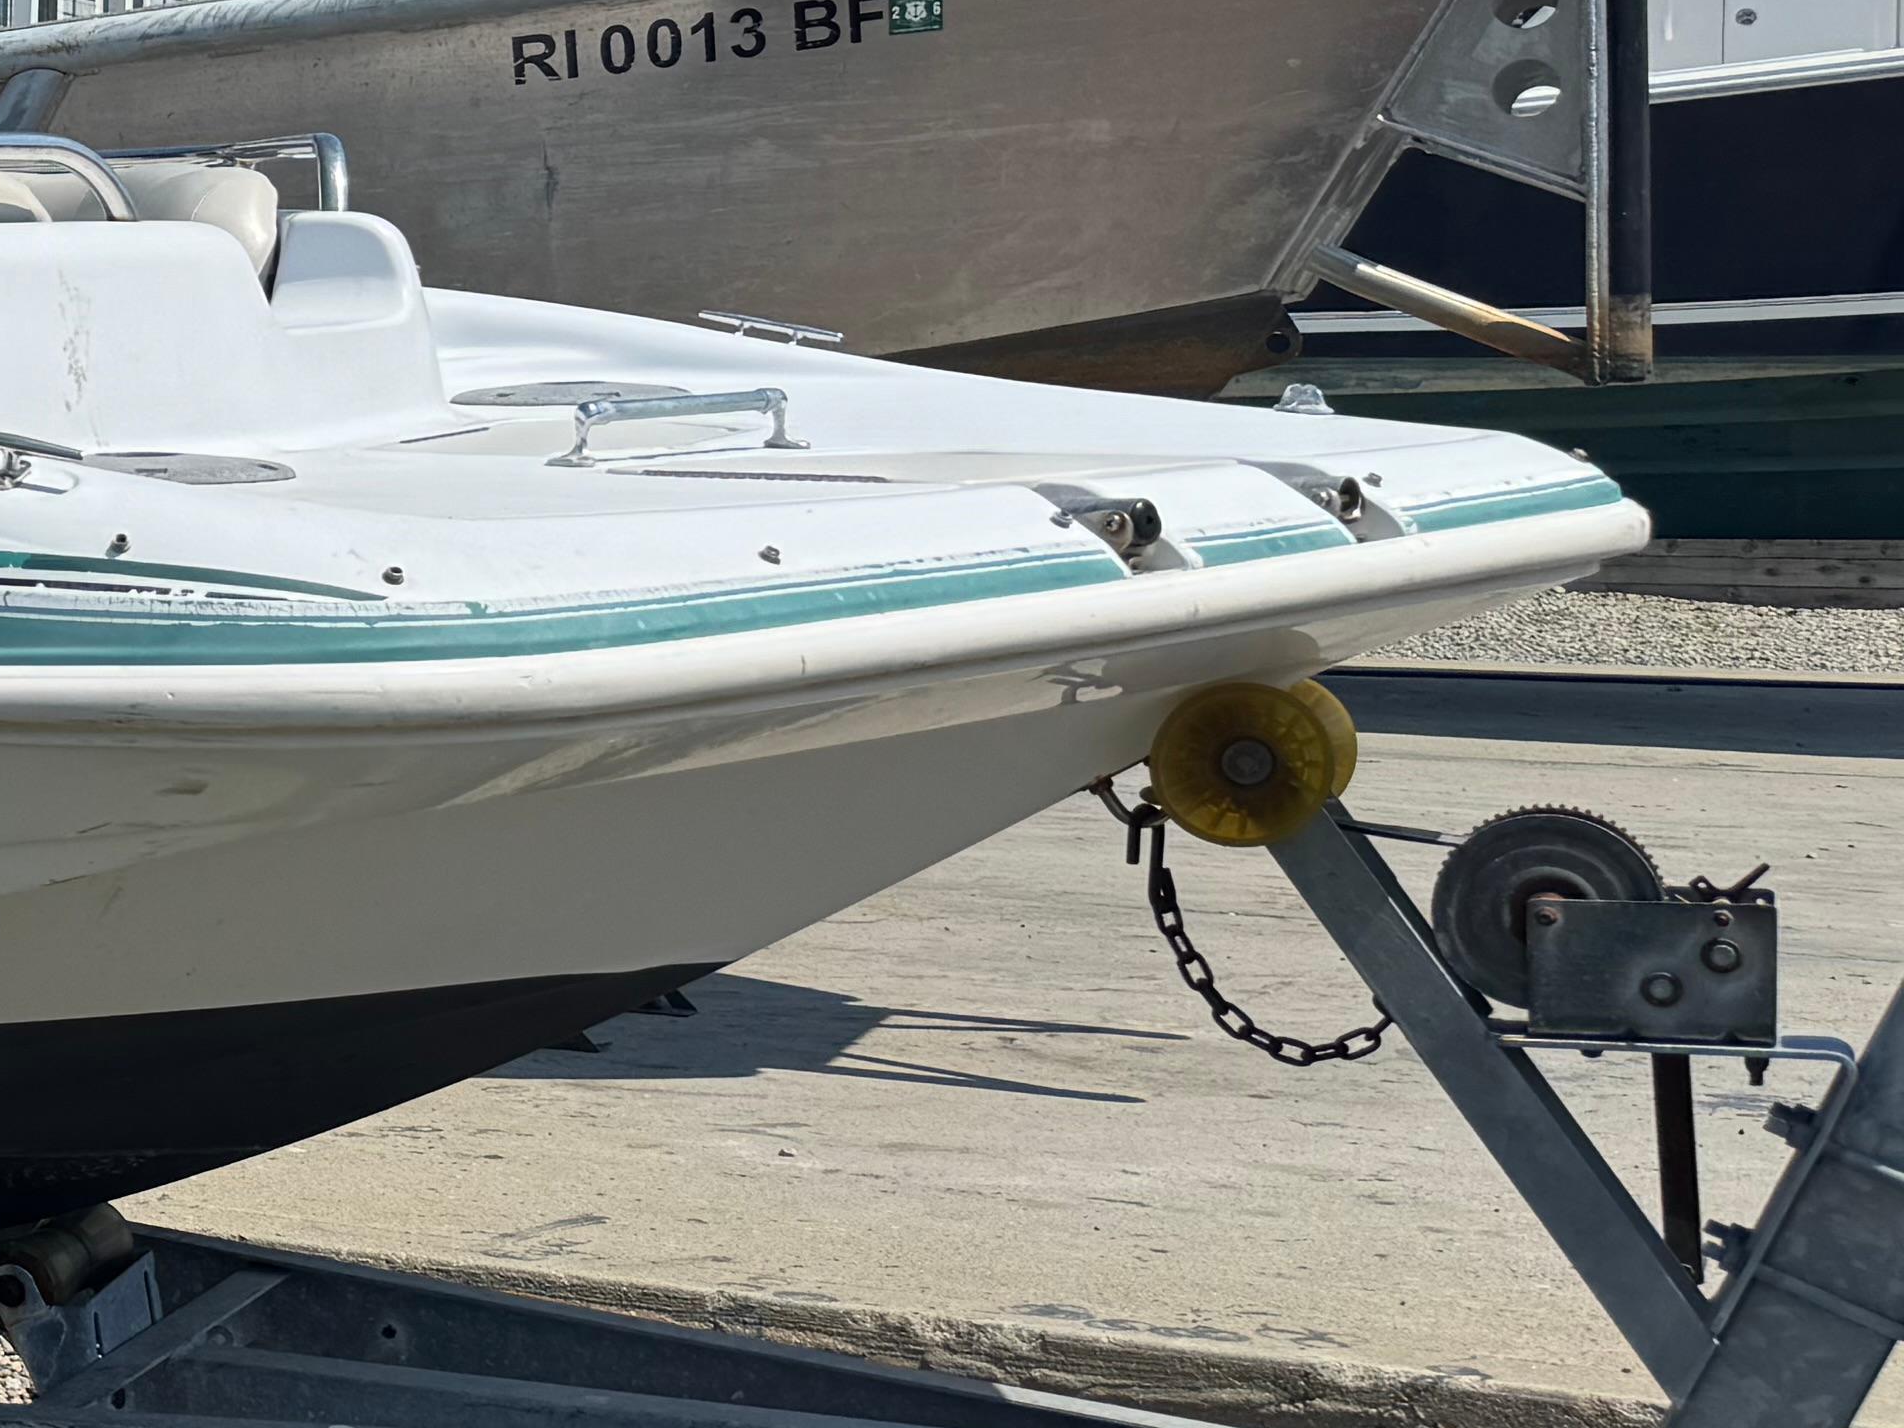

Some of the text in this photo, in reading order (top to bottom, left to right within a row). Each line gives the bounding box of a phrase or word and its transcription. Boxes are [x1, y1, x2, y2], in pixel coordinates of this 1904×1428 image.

[891, 0, 942, 20] 2 6
[511, 29, 579, 85] RI
[599, 7, 767, 74] 0013
